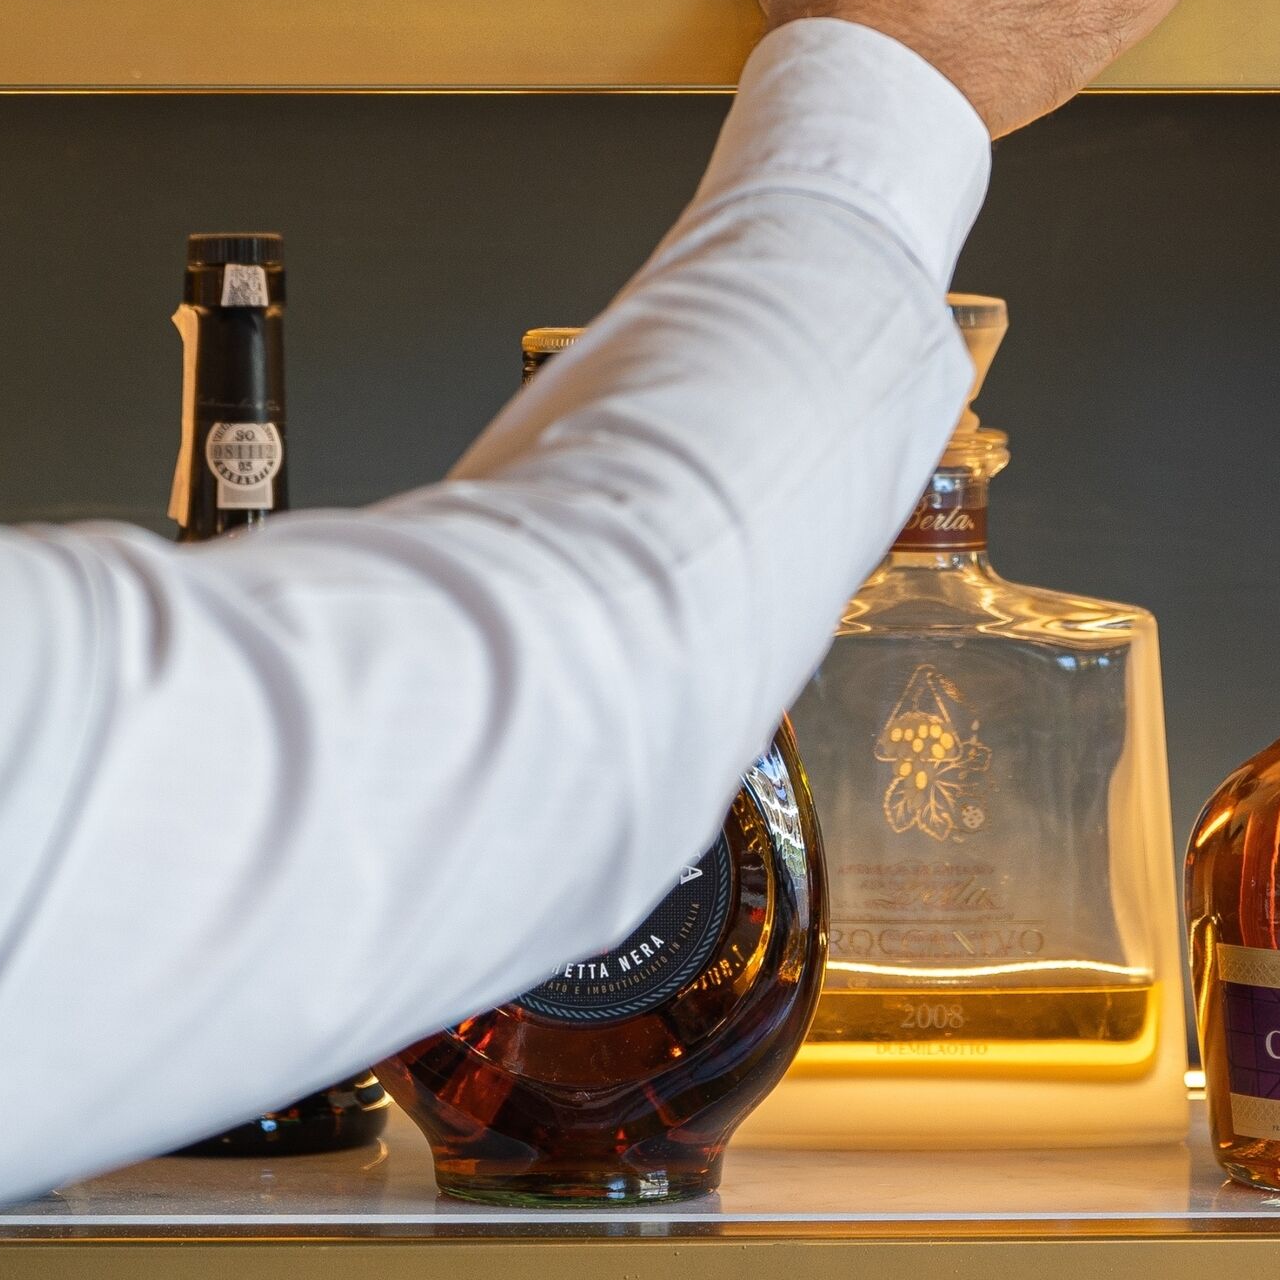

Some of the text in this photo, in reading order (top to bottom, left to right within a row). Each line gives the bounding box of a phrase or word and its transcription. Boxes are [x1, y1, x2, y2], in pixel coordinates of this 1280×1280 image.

[586, 955, 669, 995] IMBOTTIGLIATO
[679, 901, 701, 940] ITALIA
[617, 933, 665, 972] NERA
[900, 1003, 965, 1029] 2008
[876, 1043, 989, 1056] DUEMILAOTTO
